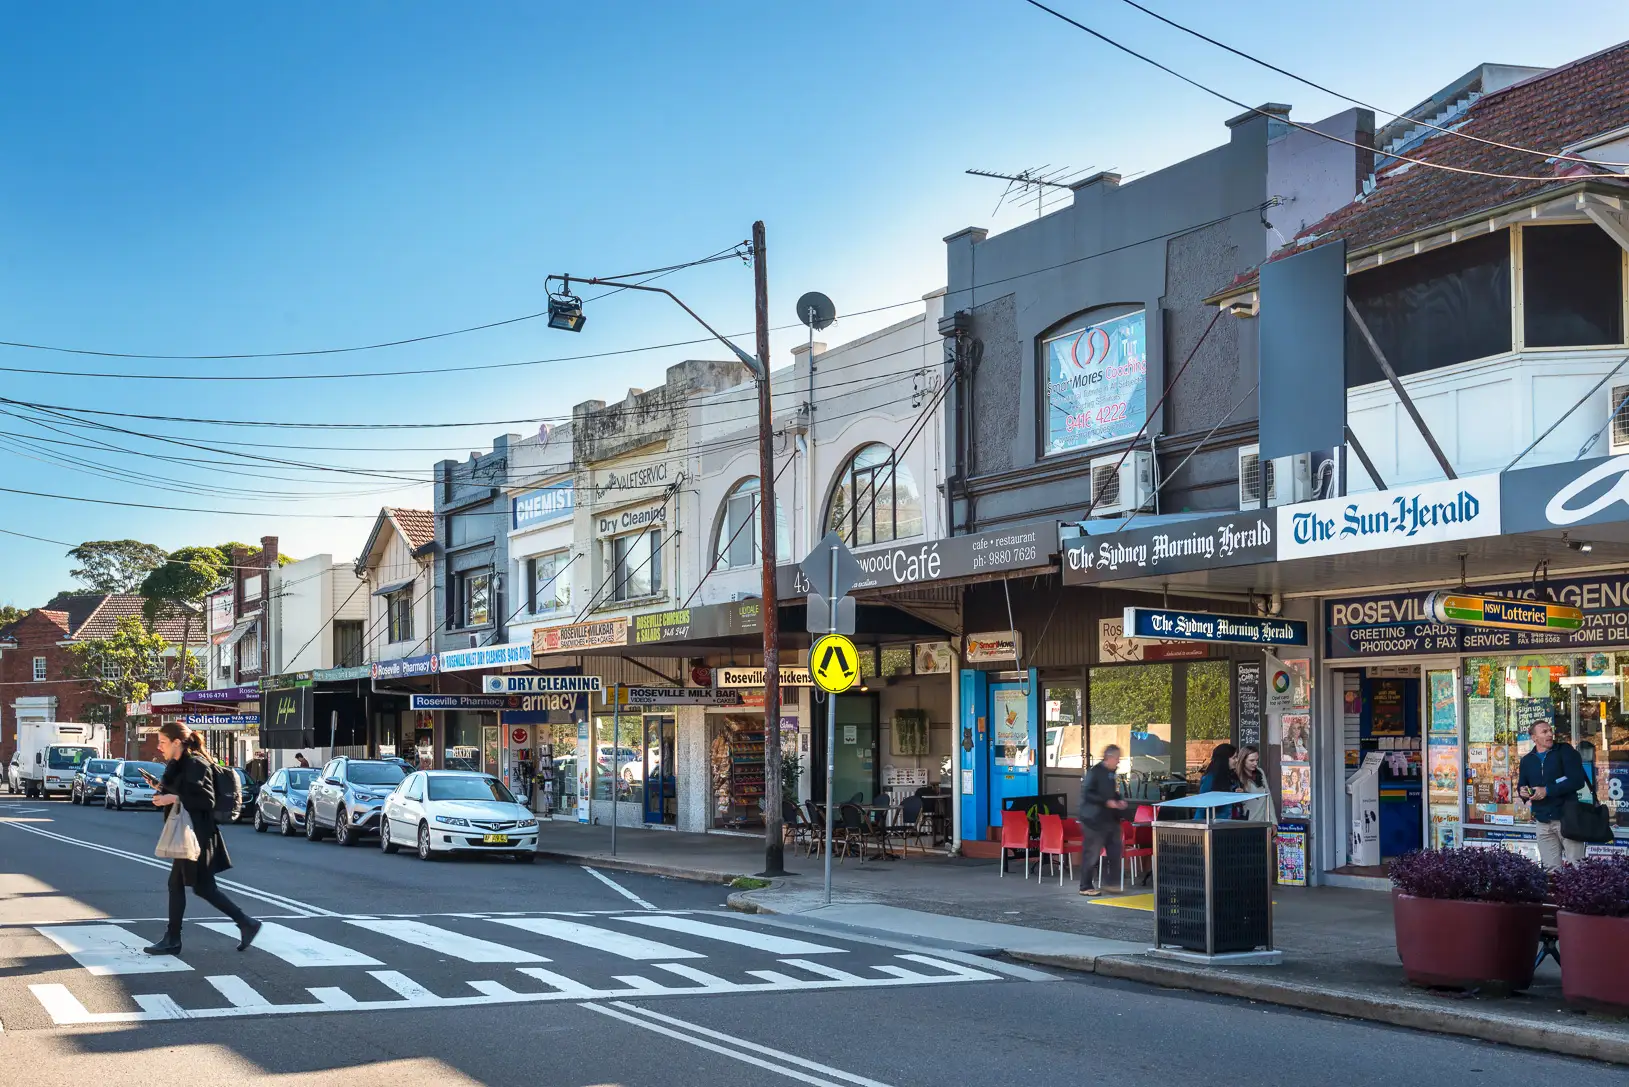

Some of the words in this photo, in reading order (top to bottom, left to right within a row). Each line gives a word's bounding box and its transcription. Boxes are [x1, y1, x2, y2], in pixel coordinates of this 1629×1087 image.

[1106, 359, 1146, 380] Coaching
[1065, 410, 1092, 433] 9416
[1096, 402, 1127, 424] 4222
[617, 472, 638, 491] VALET
[517, 487, 574, 522] CHEMIST
[600, 518, 618, 533] Dry
[622, 506, 667, 528] Cleaning
[1292, 511, 1337, 545] The
[1339, 490, 1480, 540] Sun-Herald
[972, 538, 989, 551] cafe
[995, 532, 1036, 547] restaurant
[1067, 544, 1095, 573] The
[1096, 541, 1147, 570] Sydney
[1151, 532, 1215, 566] Morning
[1217, 519, 1271, 558] Herald
[857, 550, 892, 573] wood
[893, 542, 941, 583] Café
[973, 553, 987, 569] ph:
[989, 549, 1011, 566] 9880
[1013, 545, 1036, 560] 7626
[636, 613, 663, 630] ROSEVILLE
[662, 609, 690, 628] CHICKENS
[1333, 598, 1426, 626] ROSEVIL
[1484, 603, 1501, 614] NSW
[1501, 604, 1546, 624] Lotteries
[1582, 612, 1629, 627] TATIO
[560, 626, 587, 640] ROSEVILLE
[641, 627, 661, 643] SALADS
[1103, 623, 1124, 637] Ros
[1151, 615, 1174, 634] The
[1174, 615, 1214, 638] Sydney
[1216, 618, 1260, 641] Morning
[1261, 621, 1294, 642] Herald
[1350, 626, 1406, 641] GREETING
[1414, 624, 1457, 637] CARDS
[1569, 628, 1604, 642] HOME
[560, 638, 585, 648] SANDWICHES
[600, 634, 614, 643] CAKES
[980, 640, 1015, 650] SmartMove
[1360, 638, 1419, 653] PHOTOCOPY
[1424, 638, 1433, 649] &
[1436, 636, 1457, 649] FAX
[1463, 633, 1510, 647] SERVICE
[378, 661, 400, 676] Roseville
[402, 660, 430, 674] Pharmacy
[445, 653, 466, 669] ROSEVILLE
[486, 648, 506, 664] CLEANERS
[507, 677, 534, 691] DRY
[537, 676, 600, 691] CLEANING
[724, 671, 765, 684] Roseville
[779, 670, 812, 683] hickens
[416, 696, 458, 706] Roseville
[460, 696, 505, 708] Pharmacy
[630, 688, 685, 698] ROSEVILLE
[688, 689, 712, 698] MILK
[715, 690, 736, 698] BAR
[522, 692, 578, 714] armacy
[1518, 706, 1532, 714] Sign
[188, 715, 230, 724] Solicitor
[1607, 777, 1624, 800] 8
